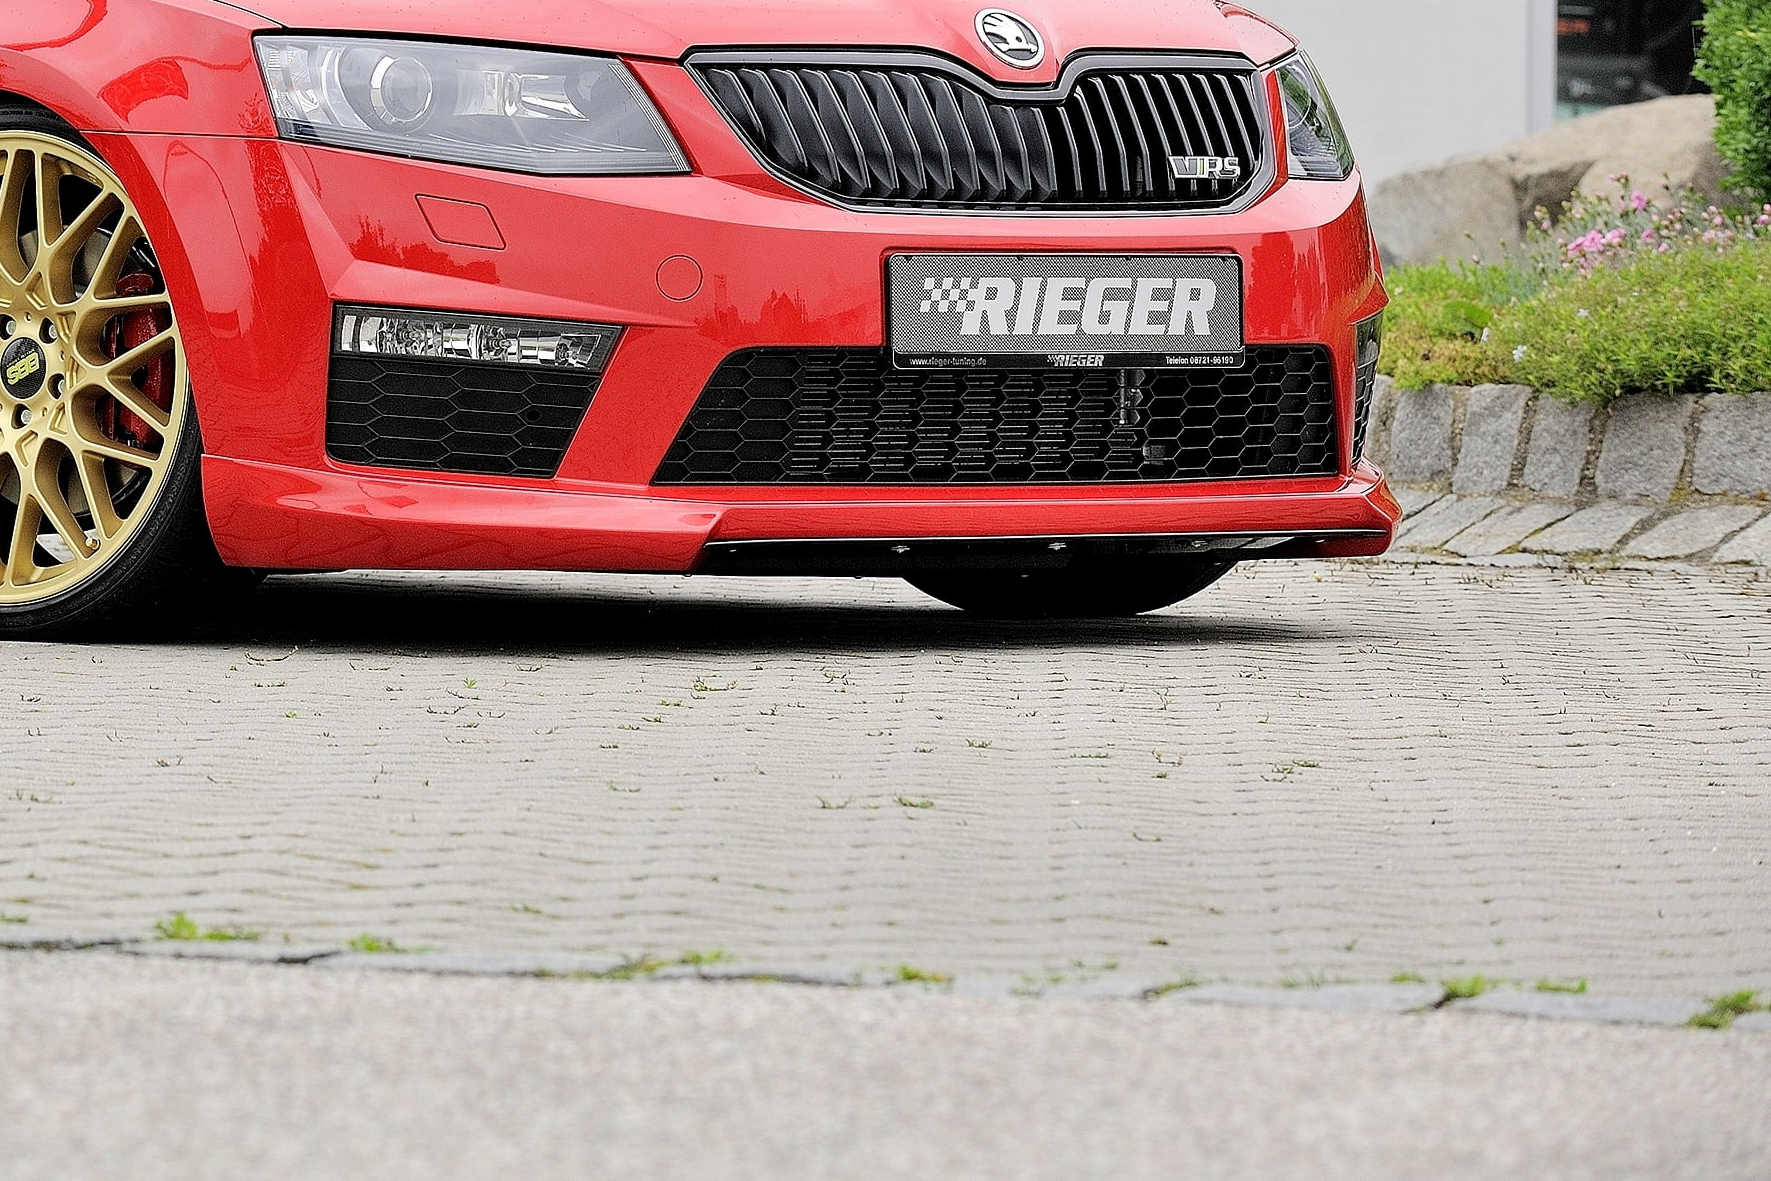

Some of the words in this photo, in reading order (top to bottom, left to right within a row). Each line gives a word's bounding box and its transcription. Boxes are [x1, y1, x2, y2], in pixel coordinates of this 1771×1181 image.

[960, 277, 1216, 335] RIEGER
[909, 356, 987, 367] www.rieger-tuning.de
[1054, 354, 1105, 367] RIEGER
[1165, 356, 1189, 366] Telefon
[6, 352, 40, 385] BBS
